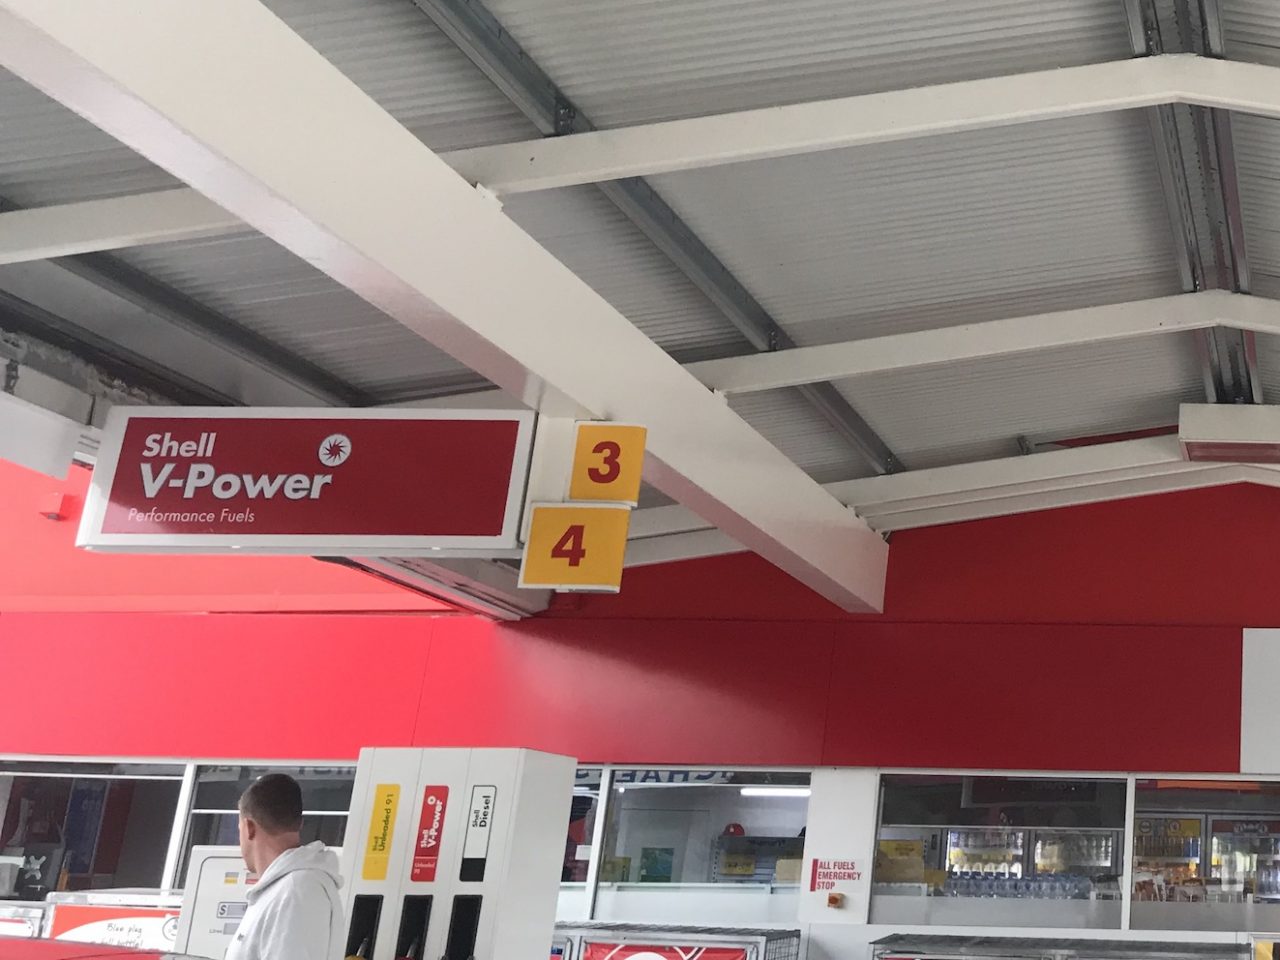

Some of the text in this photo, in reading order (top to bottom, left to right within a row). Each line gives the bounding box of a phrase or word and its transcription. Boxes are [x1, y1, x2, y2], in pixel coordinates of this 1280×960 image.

[142, 432, 217, 458] Shell
[588, 441, 621, 484] 3
[140, 462, 333, 500] V-Power
[128, 506, 255, 523] Performance Fuels
[550, 524, 586, 567] 4
[427, 799, 444, 848] V-Power
[479, 795, 492, 828] Diesel
[378, 807, 392, 852] Unleaded
[420, 829, 430, 848] Shell
[817, 871, 862, 881] EMERGENCY
[818, 861, 856, 871] ALL FUELS
[816, 881, 836, 890] STOP
